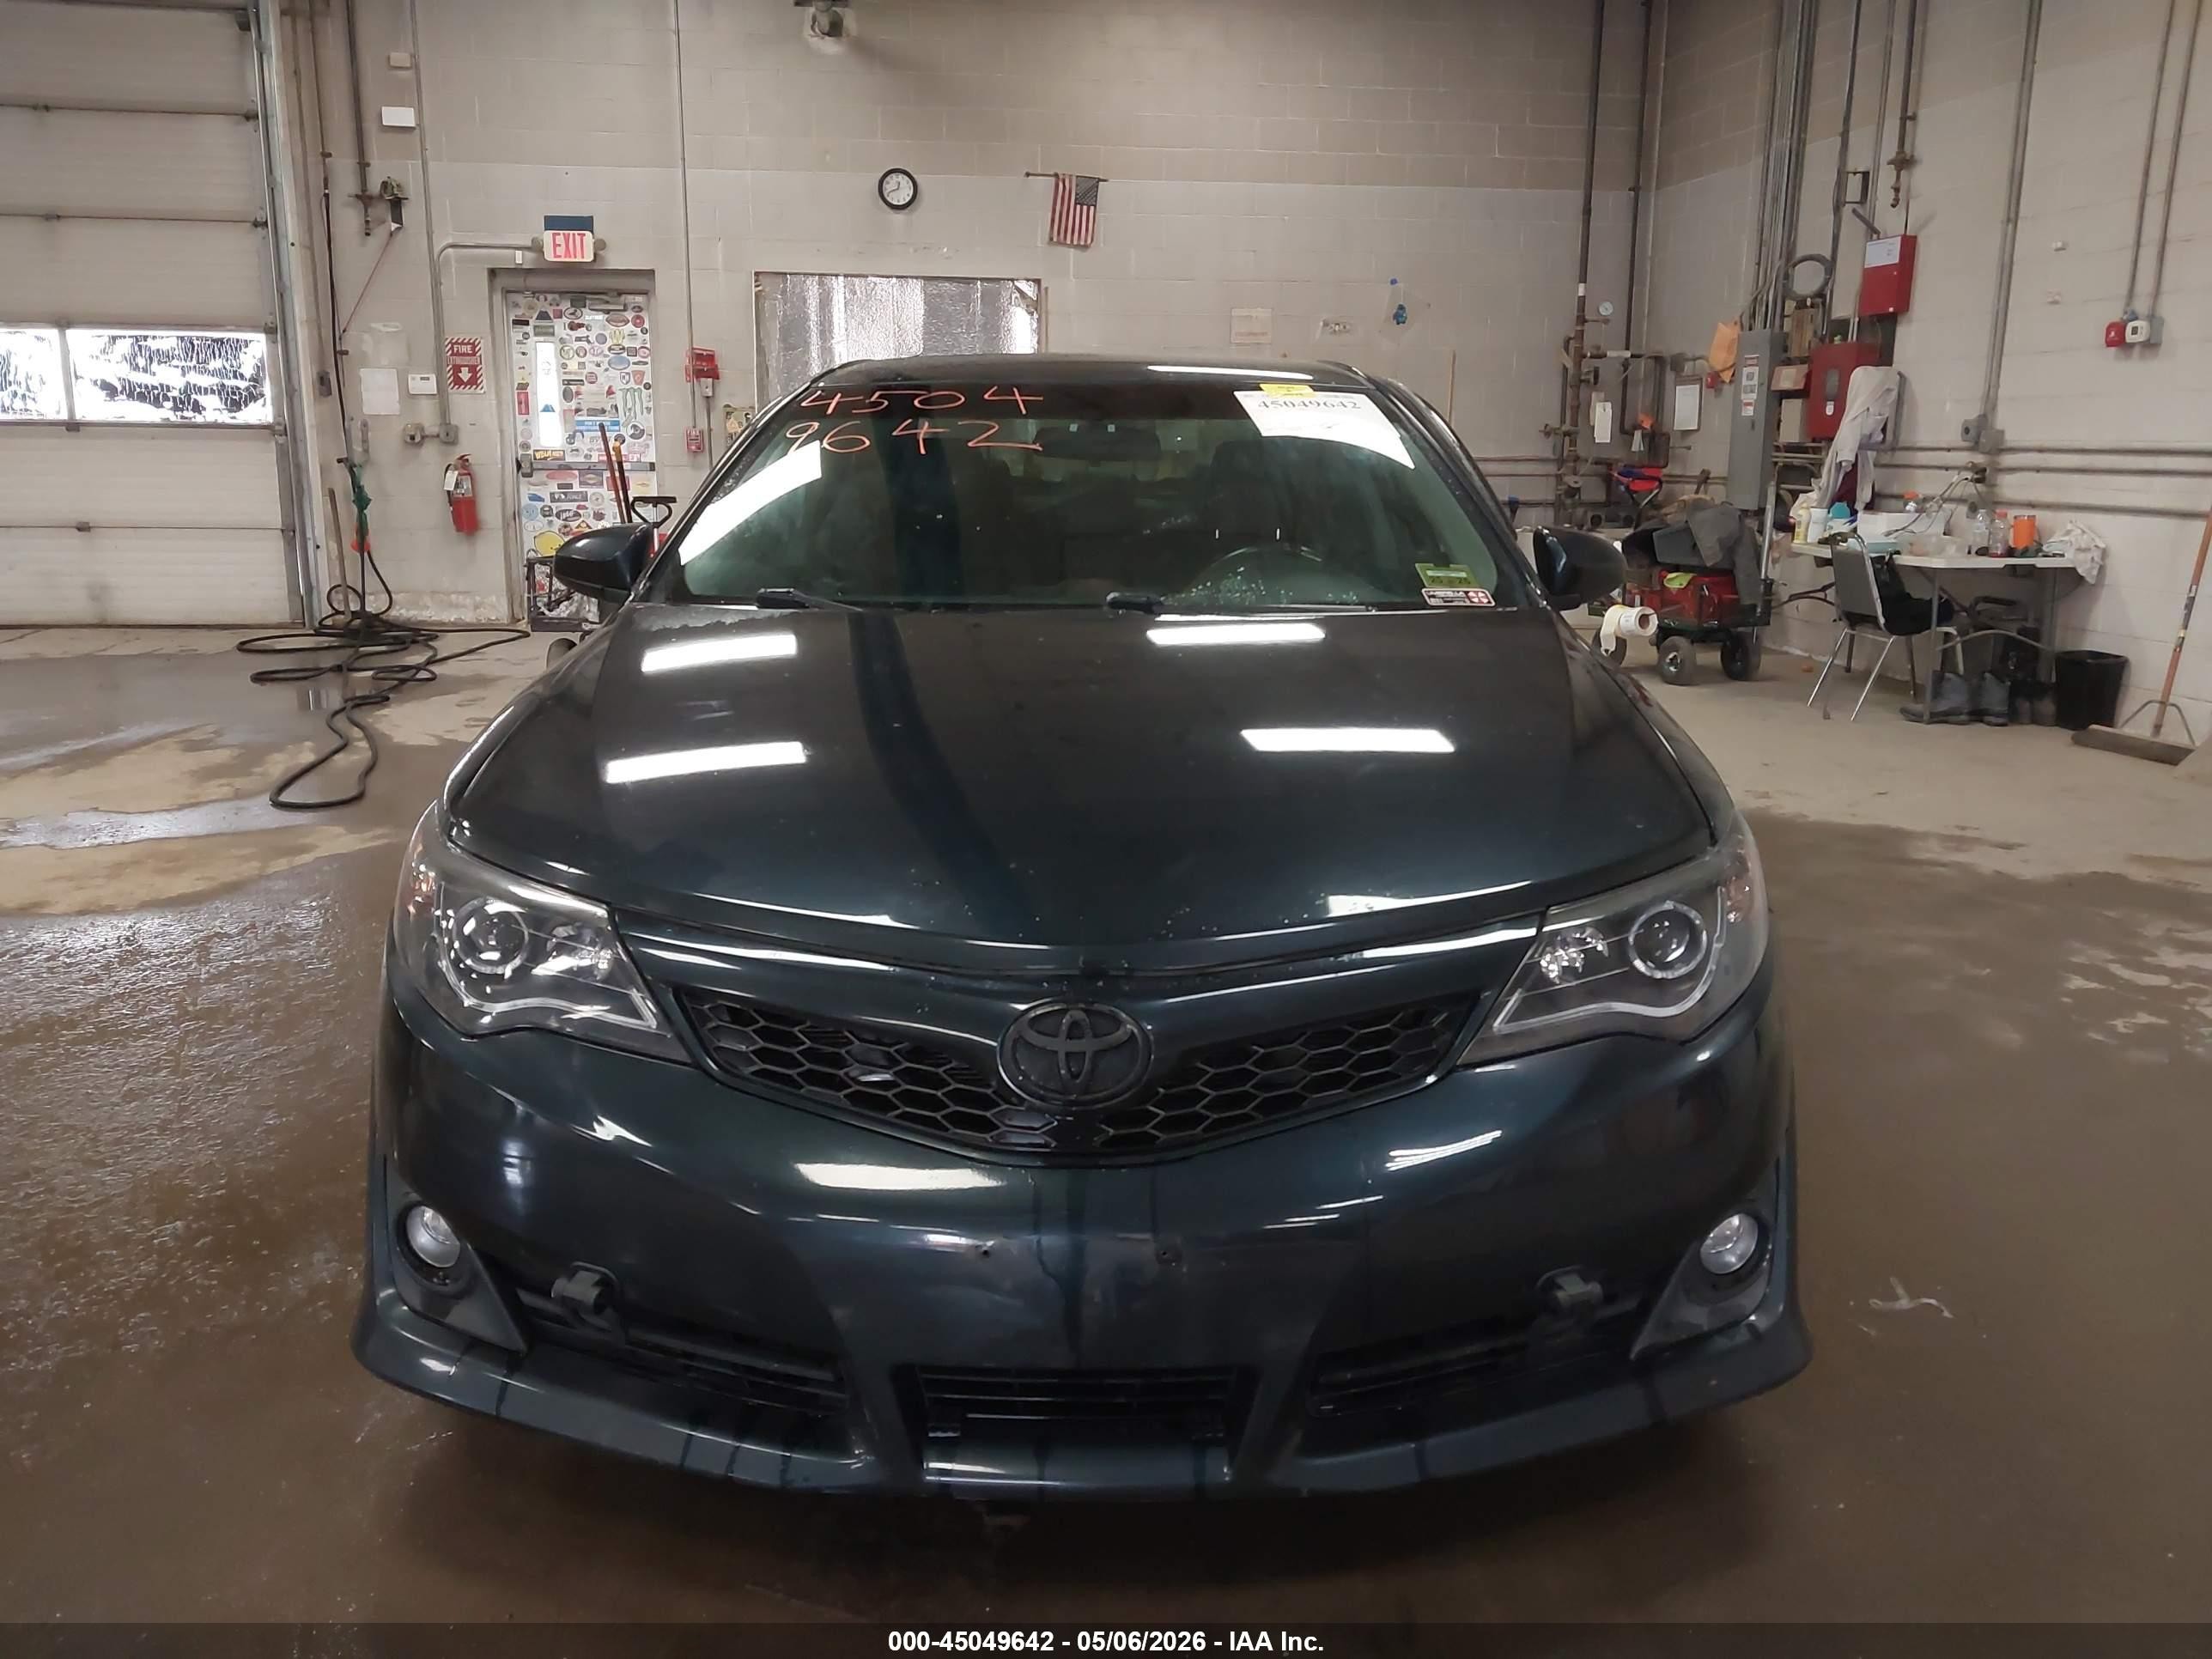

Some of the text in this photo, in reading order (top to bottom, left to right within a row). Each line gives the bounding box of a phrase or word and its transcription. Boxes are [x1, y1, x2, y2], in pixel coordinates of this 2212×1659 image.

[552, 232, 586, 259] EXIT
[453, 344, 473, 354] FIRE
[800, 386, 1043, 415] 4504
[1258, 399, 1361, 410] 45049642
[785, 418, 1043, 455] 9642
